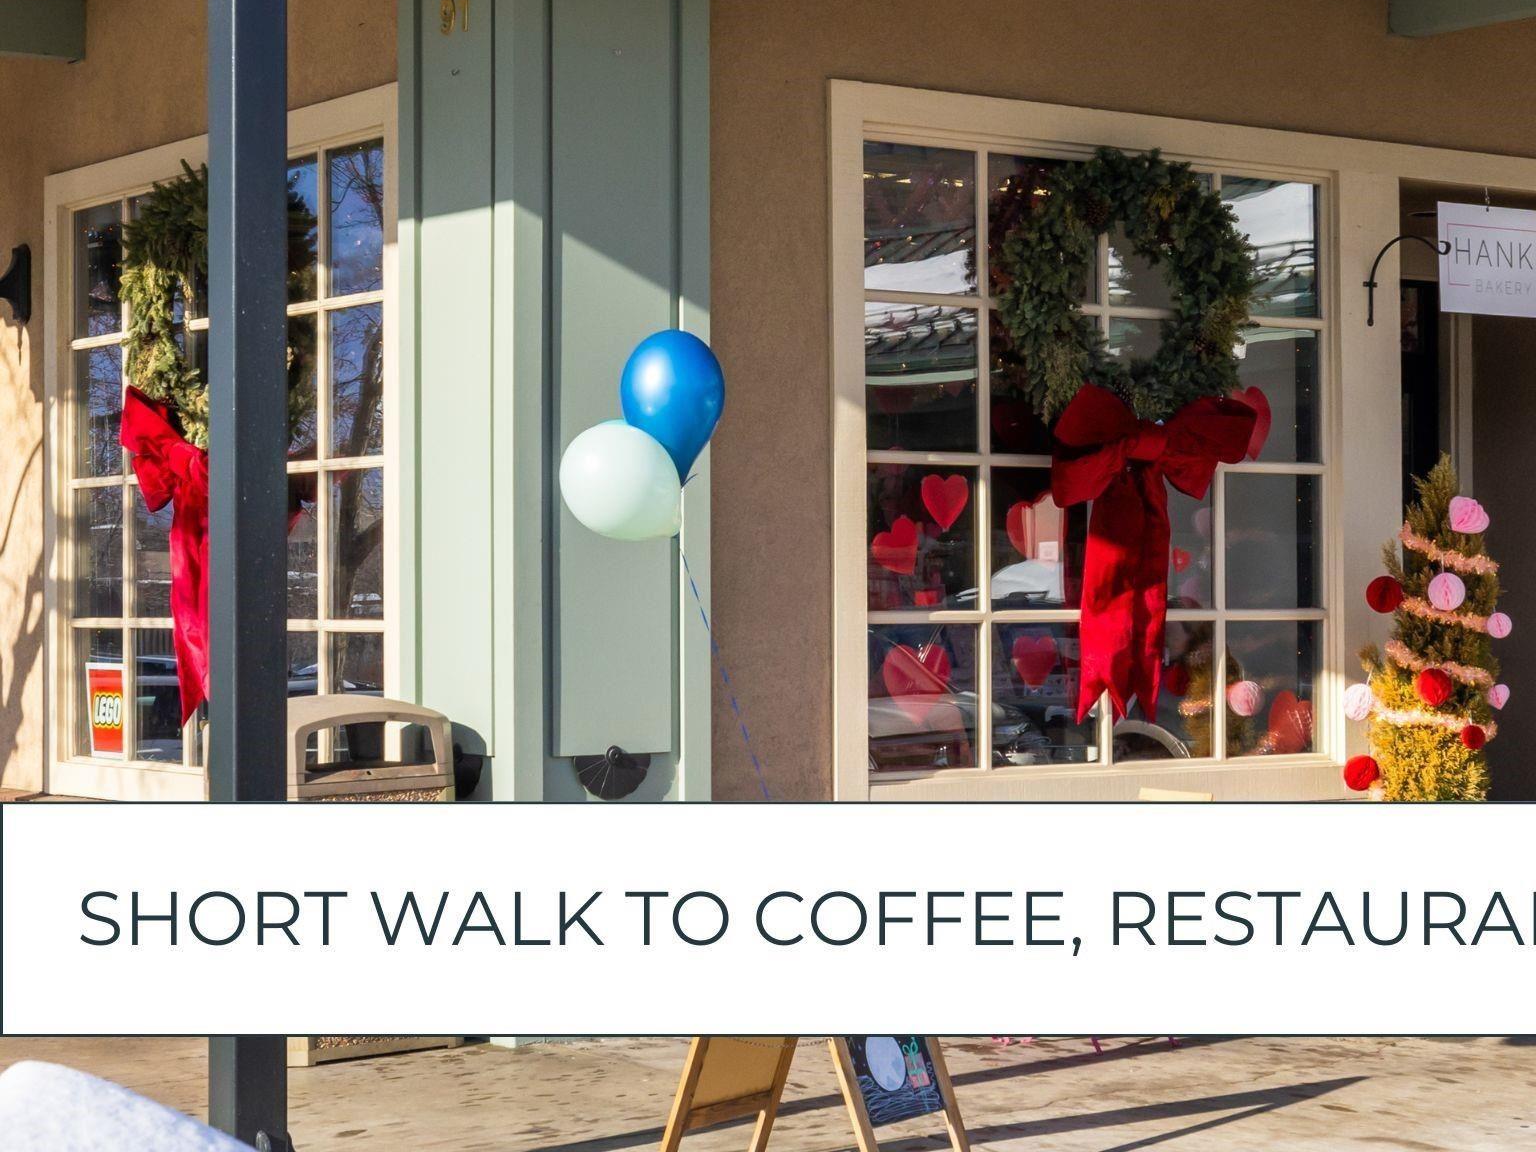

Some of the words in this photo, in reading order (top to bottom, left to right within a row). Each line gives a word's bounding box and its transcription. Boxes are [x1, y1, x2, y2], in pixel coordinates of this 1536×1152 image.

[1454, 236, 1533, 270] HANK
[1474, 278, 1532, 295] BAKERY
[94, 694, 122, 727] LEGO
